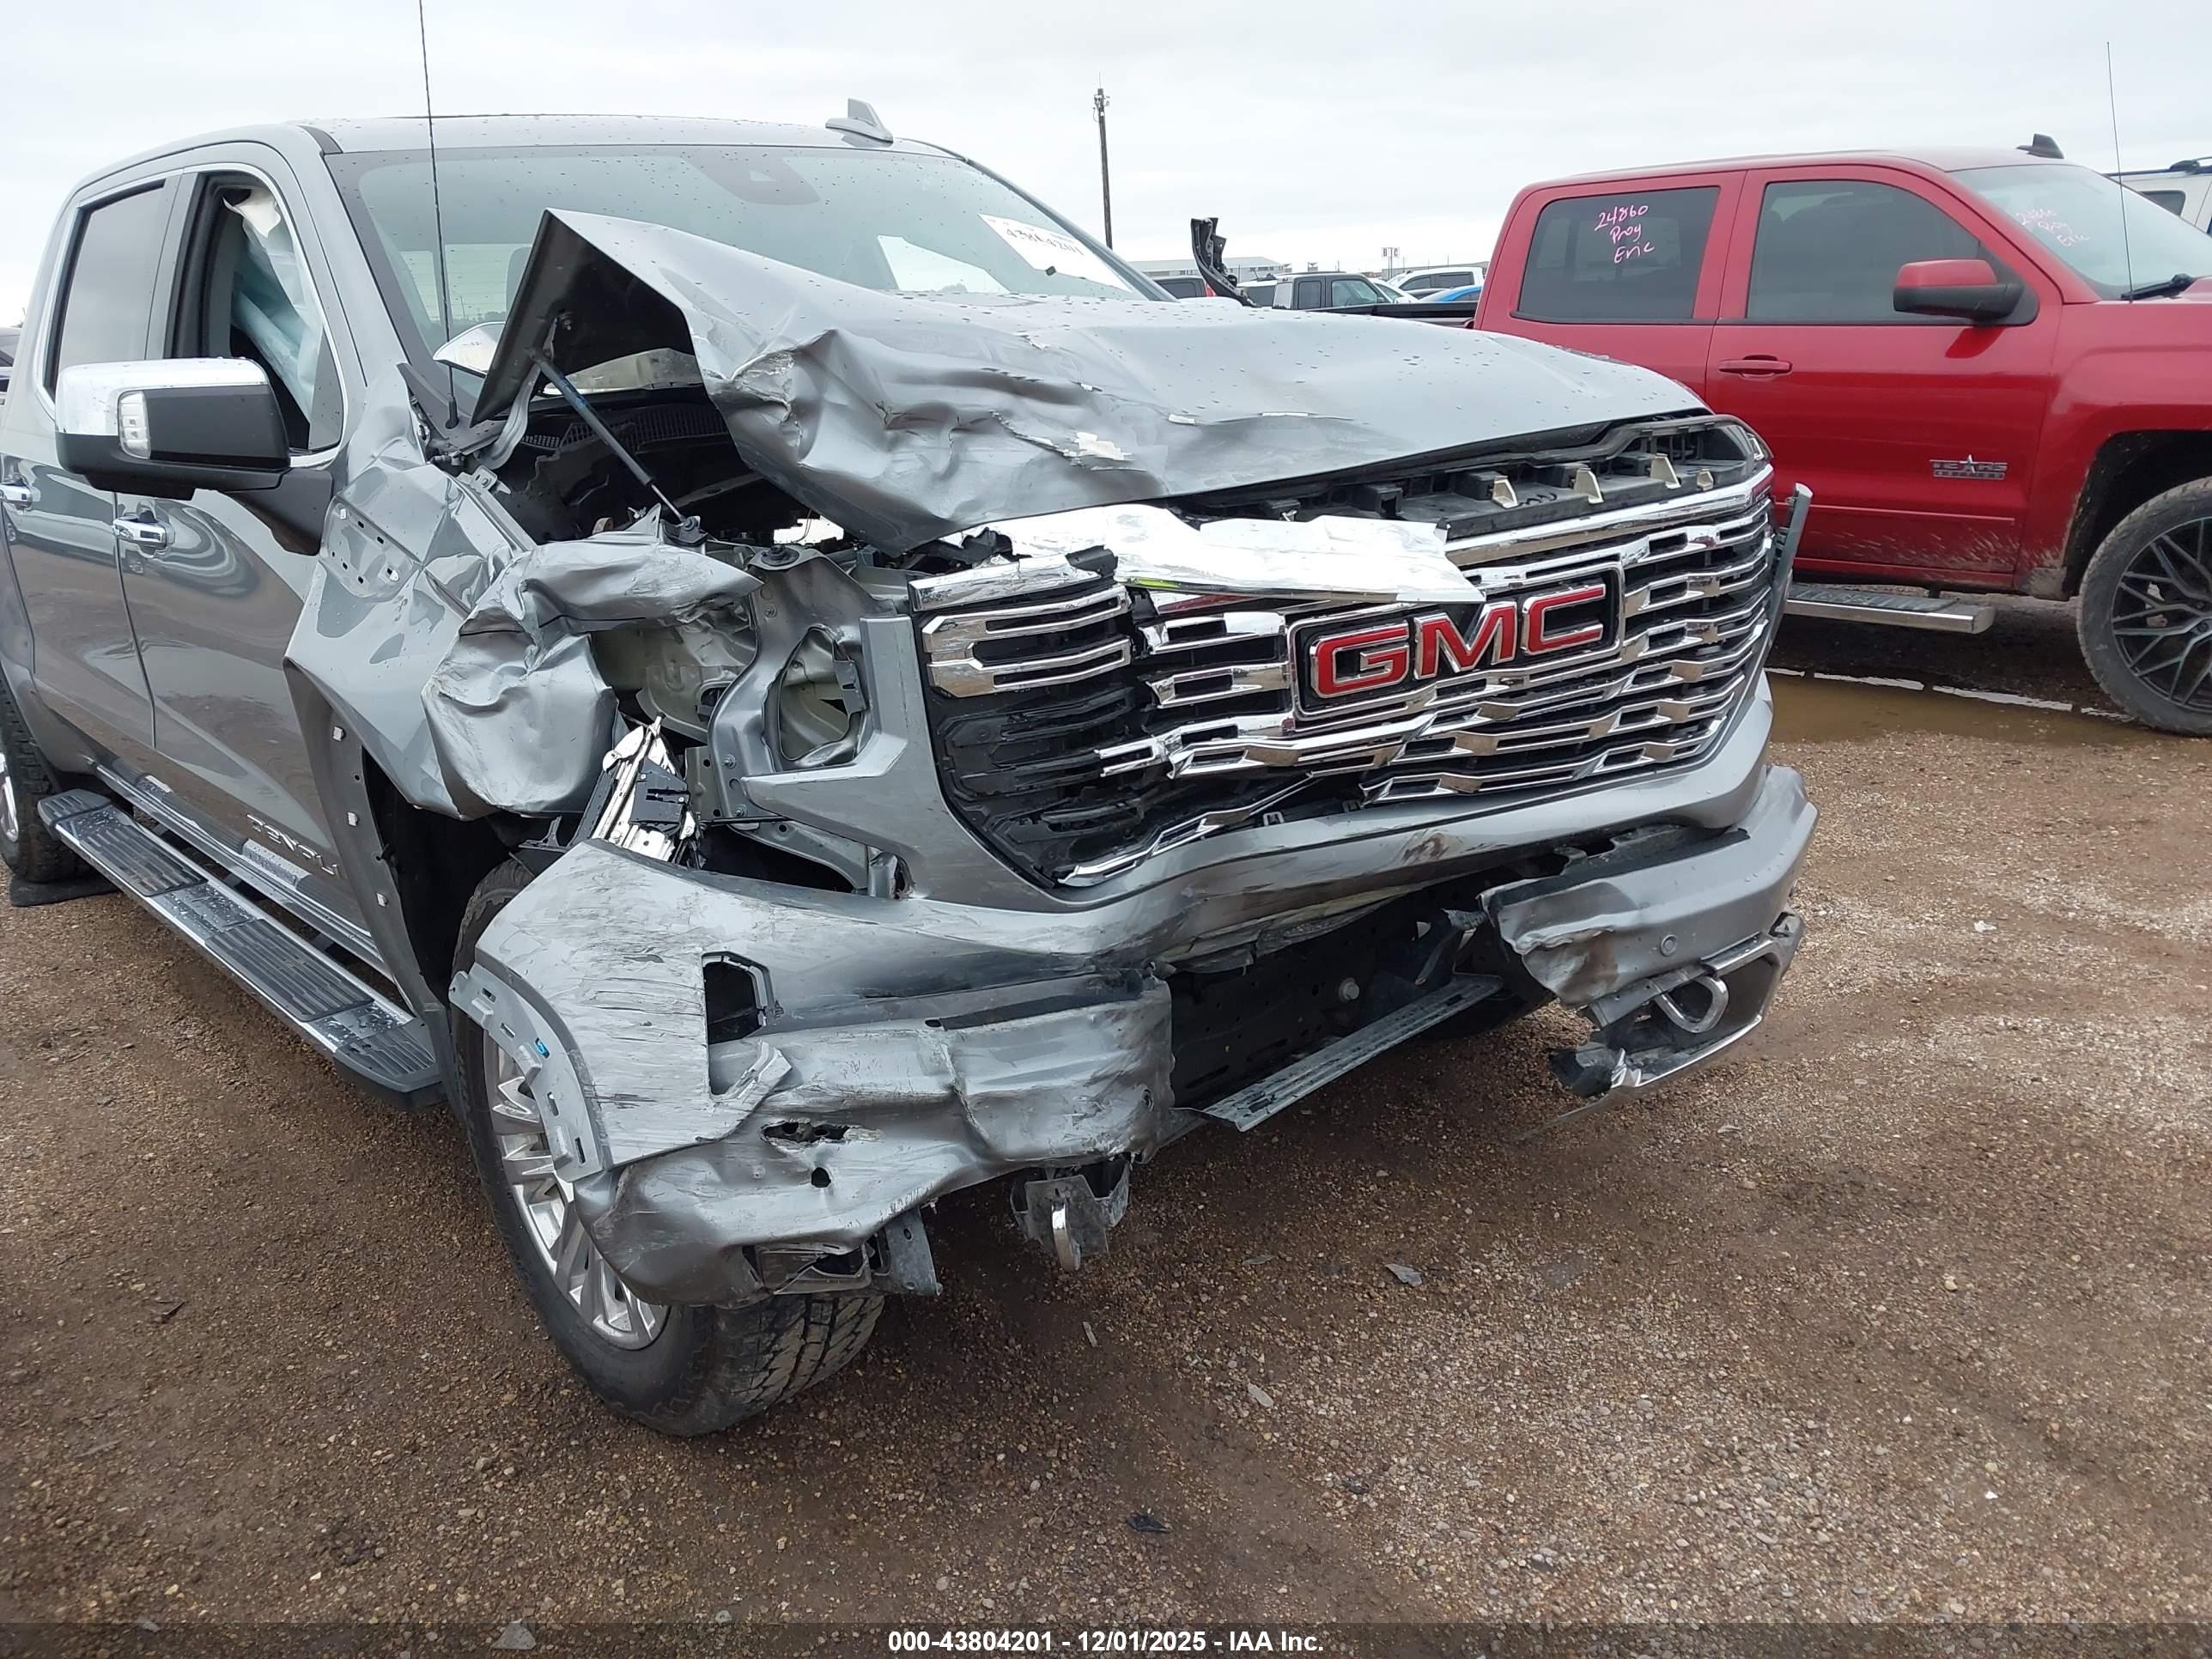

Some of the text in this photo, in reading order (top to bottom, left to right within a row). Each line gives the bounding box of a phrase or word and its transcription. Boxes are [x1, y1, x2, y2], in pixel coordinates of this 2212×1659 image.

[1594, 204, 1650, 231] 24860
[1613, 241, 1656, 264] Eric
[1310, 583, 1607, 698] GMC
